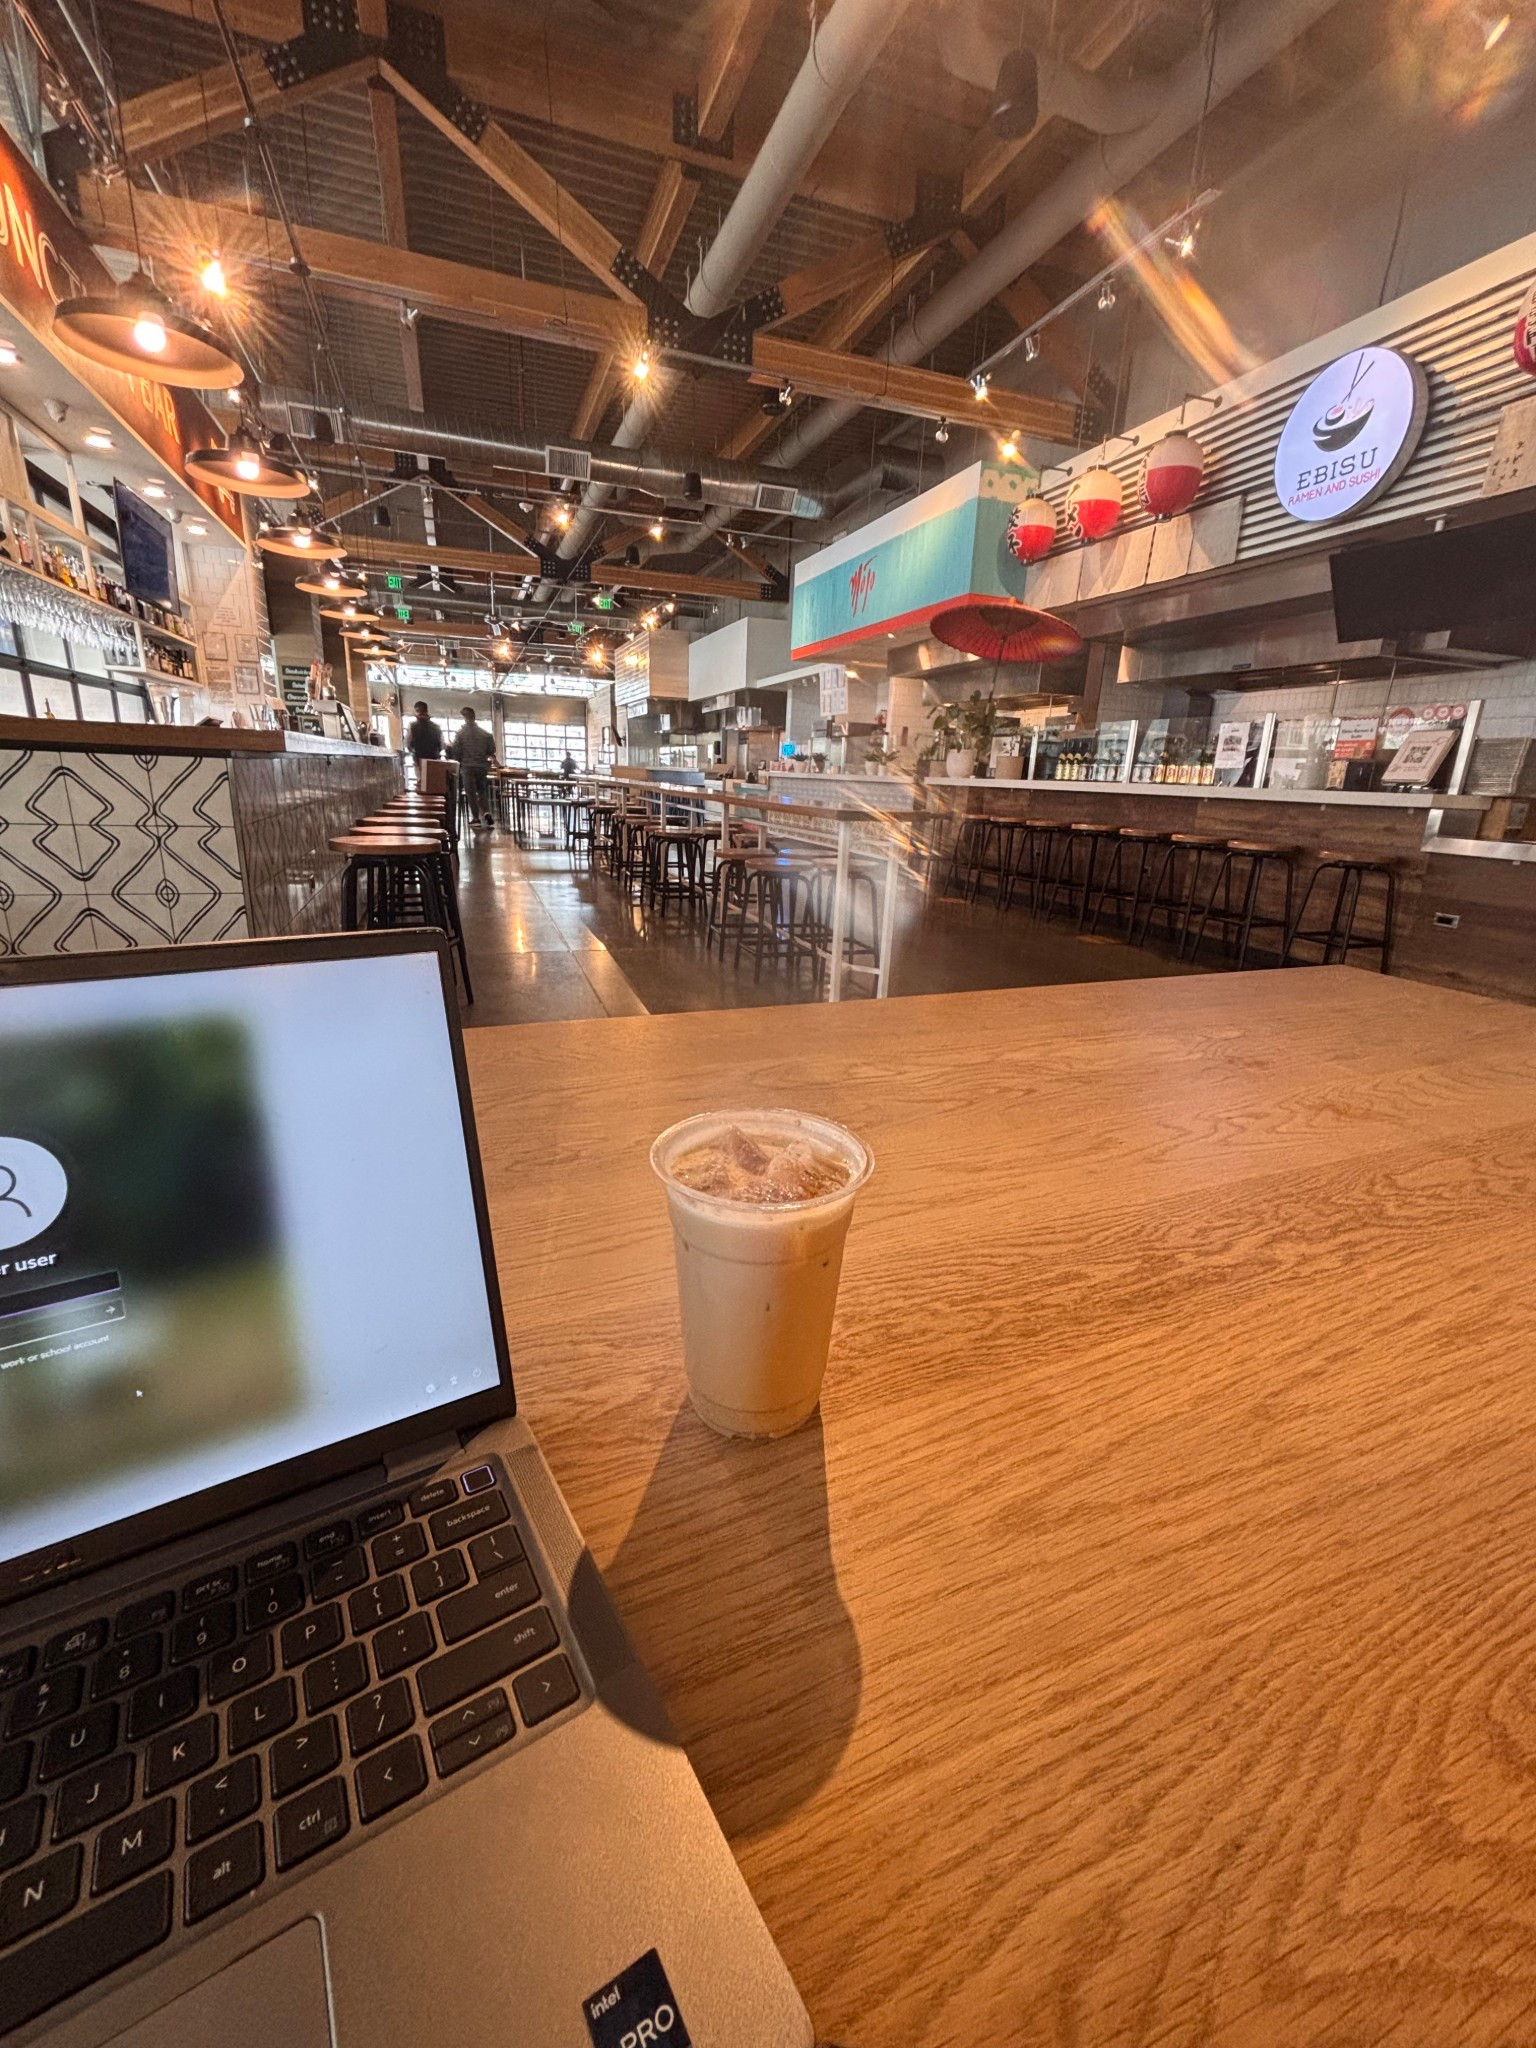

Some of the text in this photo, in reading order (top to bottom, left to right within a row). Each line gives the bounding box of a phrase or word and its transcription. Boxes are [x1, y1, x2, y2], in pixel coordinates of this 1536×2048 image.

[1296, 447, 1378, 491] EBISU
[1287, 468, 1381, 507] RAMEN AND SUSHI
[388, 576, 402, 588] EXIT
[14, 1253, 58, 1272] user
[0, 1335, 110, 1370] work or school account
[420, 1488, 445, 1501] delete
[368, 1508, 392, 1523] insert
[446, 1505, 490, 1527] backspace
[318, 1531, 335, 1543] end
[257, 1554, 283, 1568] home
[494, 1581, 519, 1599] enter
[196, 1632, 207, 1645] 9
[305, 1625, 316, 1640] P
[513, 1626, 536, 1645] shift
[119, 1665, 130, 1679] 8
[232, 1657, 247, 1673] O
[37, 1700, 47, 1715] 7
[373, 1694, 382, 1709] ?
[254, 1706, 266, 1721] L
[70, 1728, 86, 1748] U
[172, 1741, 186, 1762] K
[86, 1782, 100, 1804] J
[299, 1809, 321, 1831] ctrl
[121, 1828, 143, 1856] M
[212, 1860, 232, 1880] alt
[23, 1879, 45, 1908] N
[590, 1984, 621, 2020] intel
[620, 2004, 675, 2048] PRO
